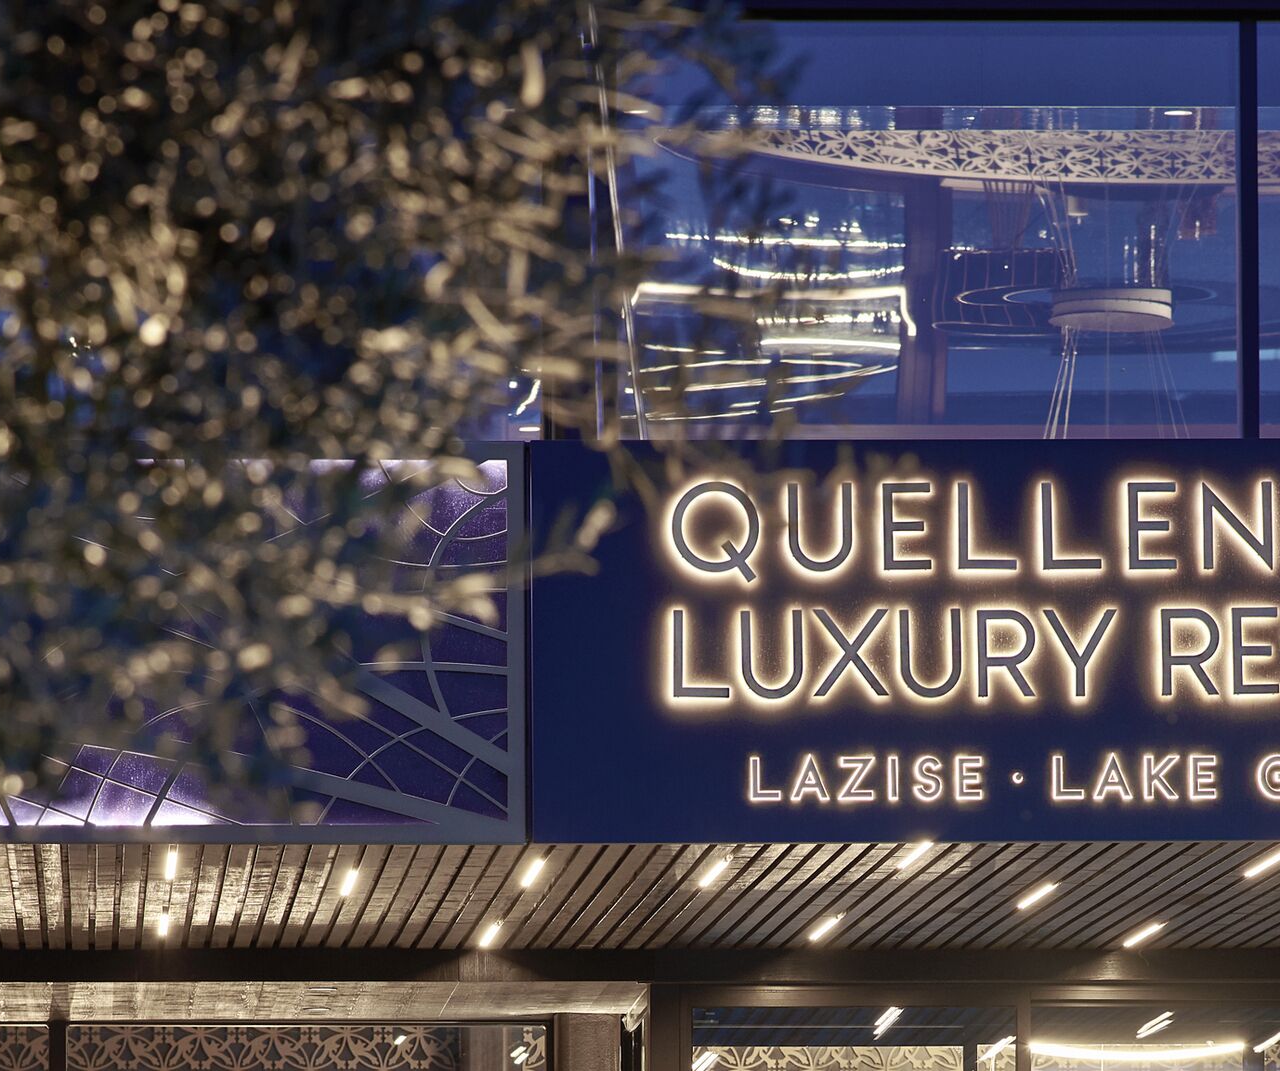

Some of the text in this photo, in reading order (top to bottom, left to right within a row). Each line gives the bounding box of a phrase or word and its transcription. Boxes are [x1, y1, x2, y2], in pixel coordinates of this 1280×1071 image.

[670, 605, 1118, 699] LUXURY
[748, 755, 986, 801] LAZISE
[1050, 754, 1220, 800] LAKE
